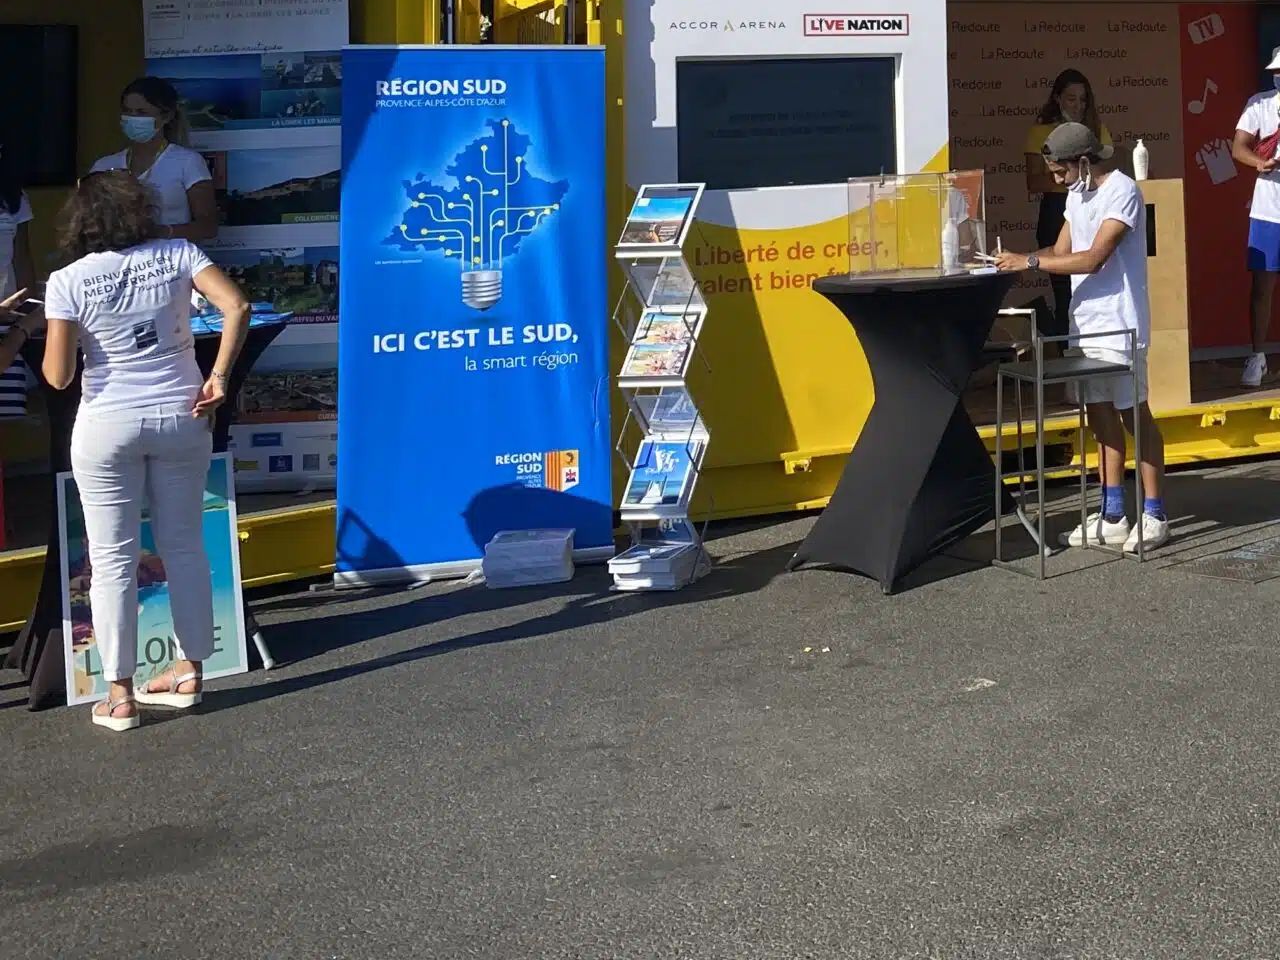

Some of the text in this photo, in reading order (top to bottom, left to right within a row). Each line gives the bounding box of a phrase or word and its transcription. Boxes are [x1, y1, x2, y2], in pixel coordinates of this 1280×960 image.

[669, 19, 787, 30] ACCOR ARENA
[811, 18, 903, 33] LIVE NATION
[952, 22, 1001, 33] Redoute
[1024, 22, 1086, 32] La Redoute
[1107, 21, 1168, 32] La Redoute
[1194, 17, 1214, 38] TV
[981, 48, 1045, 60] La Redoute
[1066, 47, 1128, 59] La Redoute
[375, 77, 507, 96] RÉGION SUD
[952, 79, 1003, 90] Redoute
[1025, 78, 1038, 89] La
[1109, 76, 1169, 87] La Redoute
[476, 98, 506, 107] D'AZUR
[982, 105, 995, 117] La
[1097, 104, 1129, 114] doute
[954, 136, 1004, 148] Redoute
[1123, 131, 1170, 143] Redoute
[998, 162, 1028, 174] Redo
[1000, 220, 1037, 231] Redou
[695, 236, 889, 267] Liberté de créer,
[83, 255, 171, 287] BIENVENUE EN
[771, 269, 819, 290] bien
[1015, 276, 1049, 289] doute
[373, 323, 579, 353] ICI C'EST LE SUD,
[465, 351, 578, 371] la smart région
[495, 452, 542, 465] RÉGION
[516, 463, 543, 474] SUD
